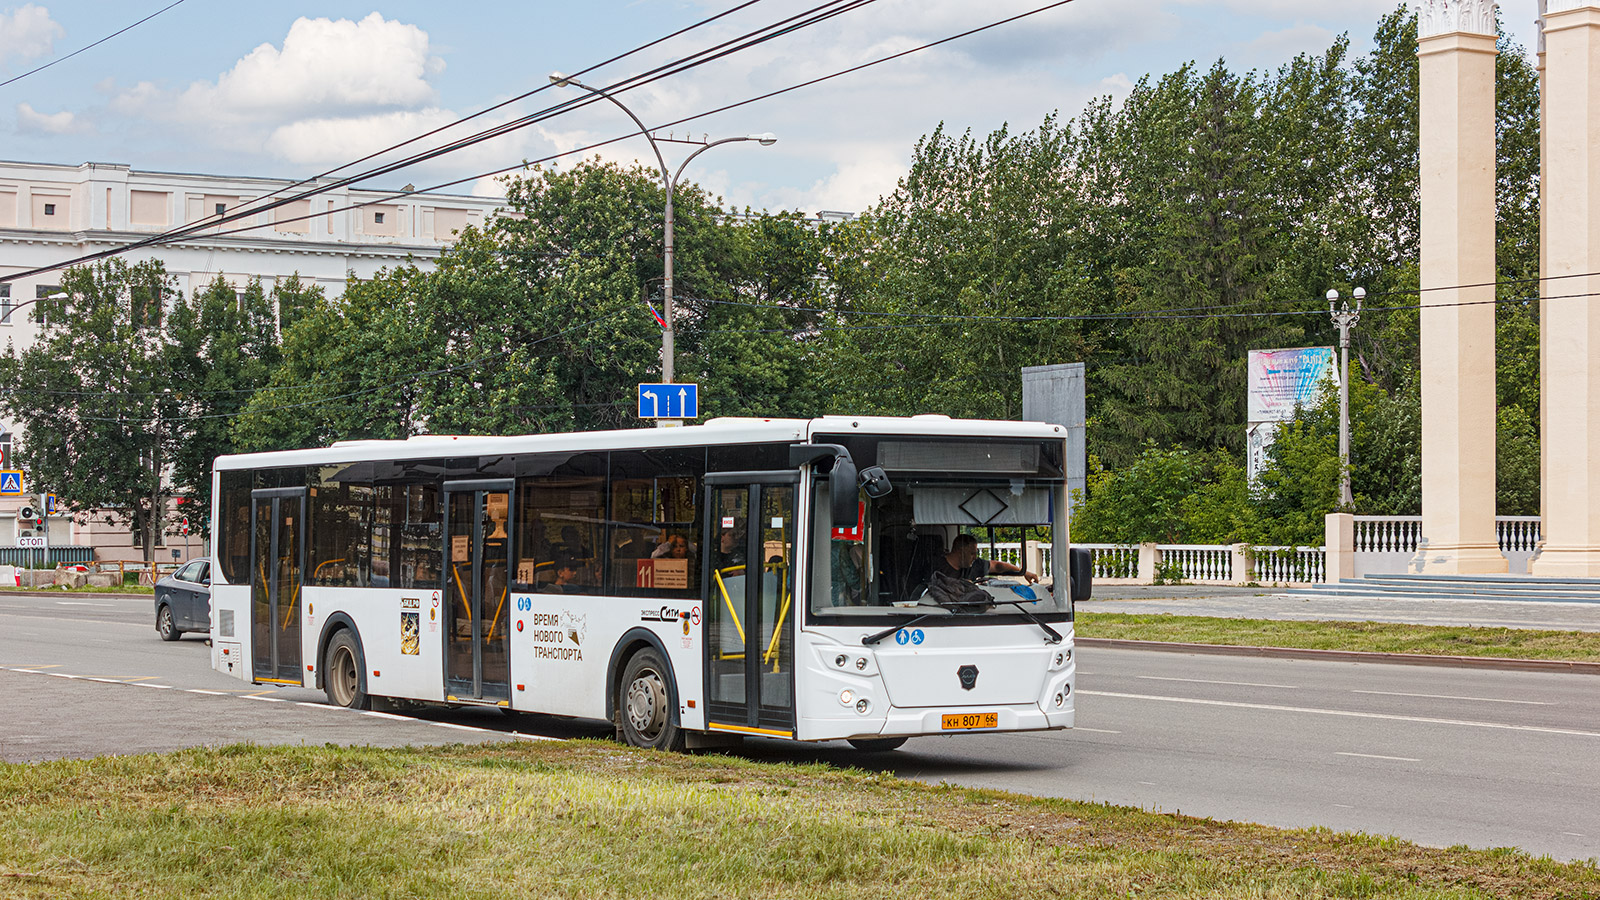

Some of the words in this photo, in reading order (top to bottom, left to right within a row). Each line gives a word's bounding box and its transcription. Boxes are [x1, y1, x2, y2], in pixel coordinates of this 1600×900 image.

[19, 537, 43, 546] СТОП
[639, 565, 652, 588] 11
[533, 613, 559, 627] ВРЕМЯ
[533, 630, 564, 644] НОВОГО
[533, 646, 583, 662] ТРАНСПОРТА
[963, 715, 981, 727] 807
[985, 714, 995, 722] 66
